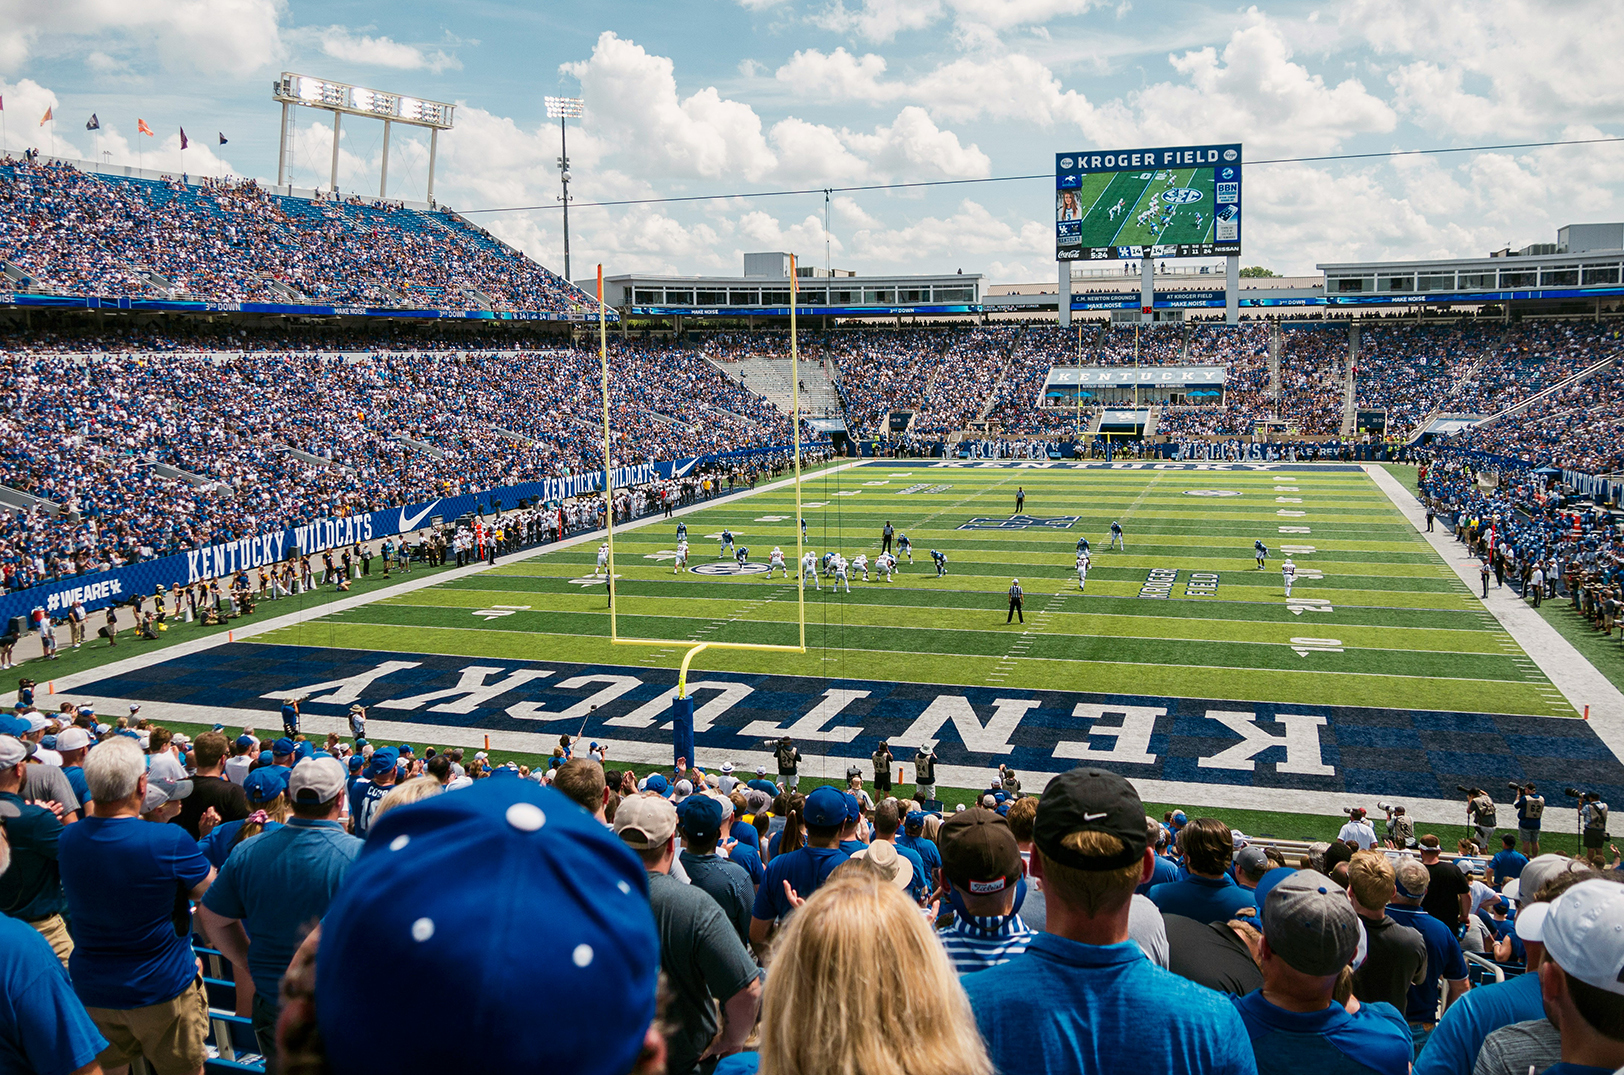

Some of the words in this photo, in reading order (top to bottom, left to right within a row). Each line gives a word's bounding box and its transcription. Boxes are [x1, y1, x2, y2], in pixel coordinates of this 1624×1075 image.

[1078, 153, 1155, 169] KROGER
[1164, 150, 1219, 165] FIELD
[1218, 184, 1237, 192] BBN
[217, 303, 241, 311] DOWN
[334, 307, 350, 315] MAKE
[1057, 372, 1215, 381] KENTUCKY
[928, 462, 1281, 471] KENTUCKY
[543, 472, 601, 500] KENTUCKY
[187, 530, 285, 585] KENTUCKY
[294, 512, 372, 556] WILDCATS
[1137, 568, 1180, 599] KROGER
[1184, 573, 1220, 597] FIELD
[258, 660, 1336, 777] KENTUCKY
[1530, 804, 1541, 813] 62
